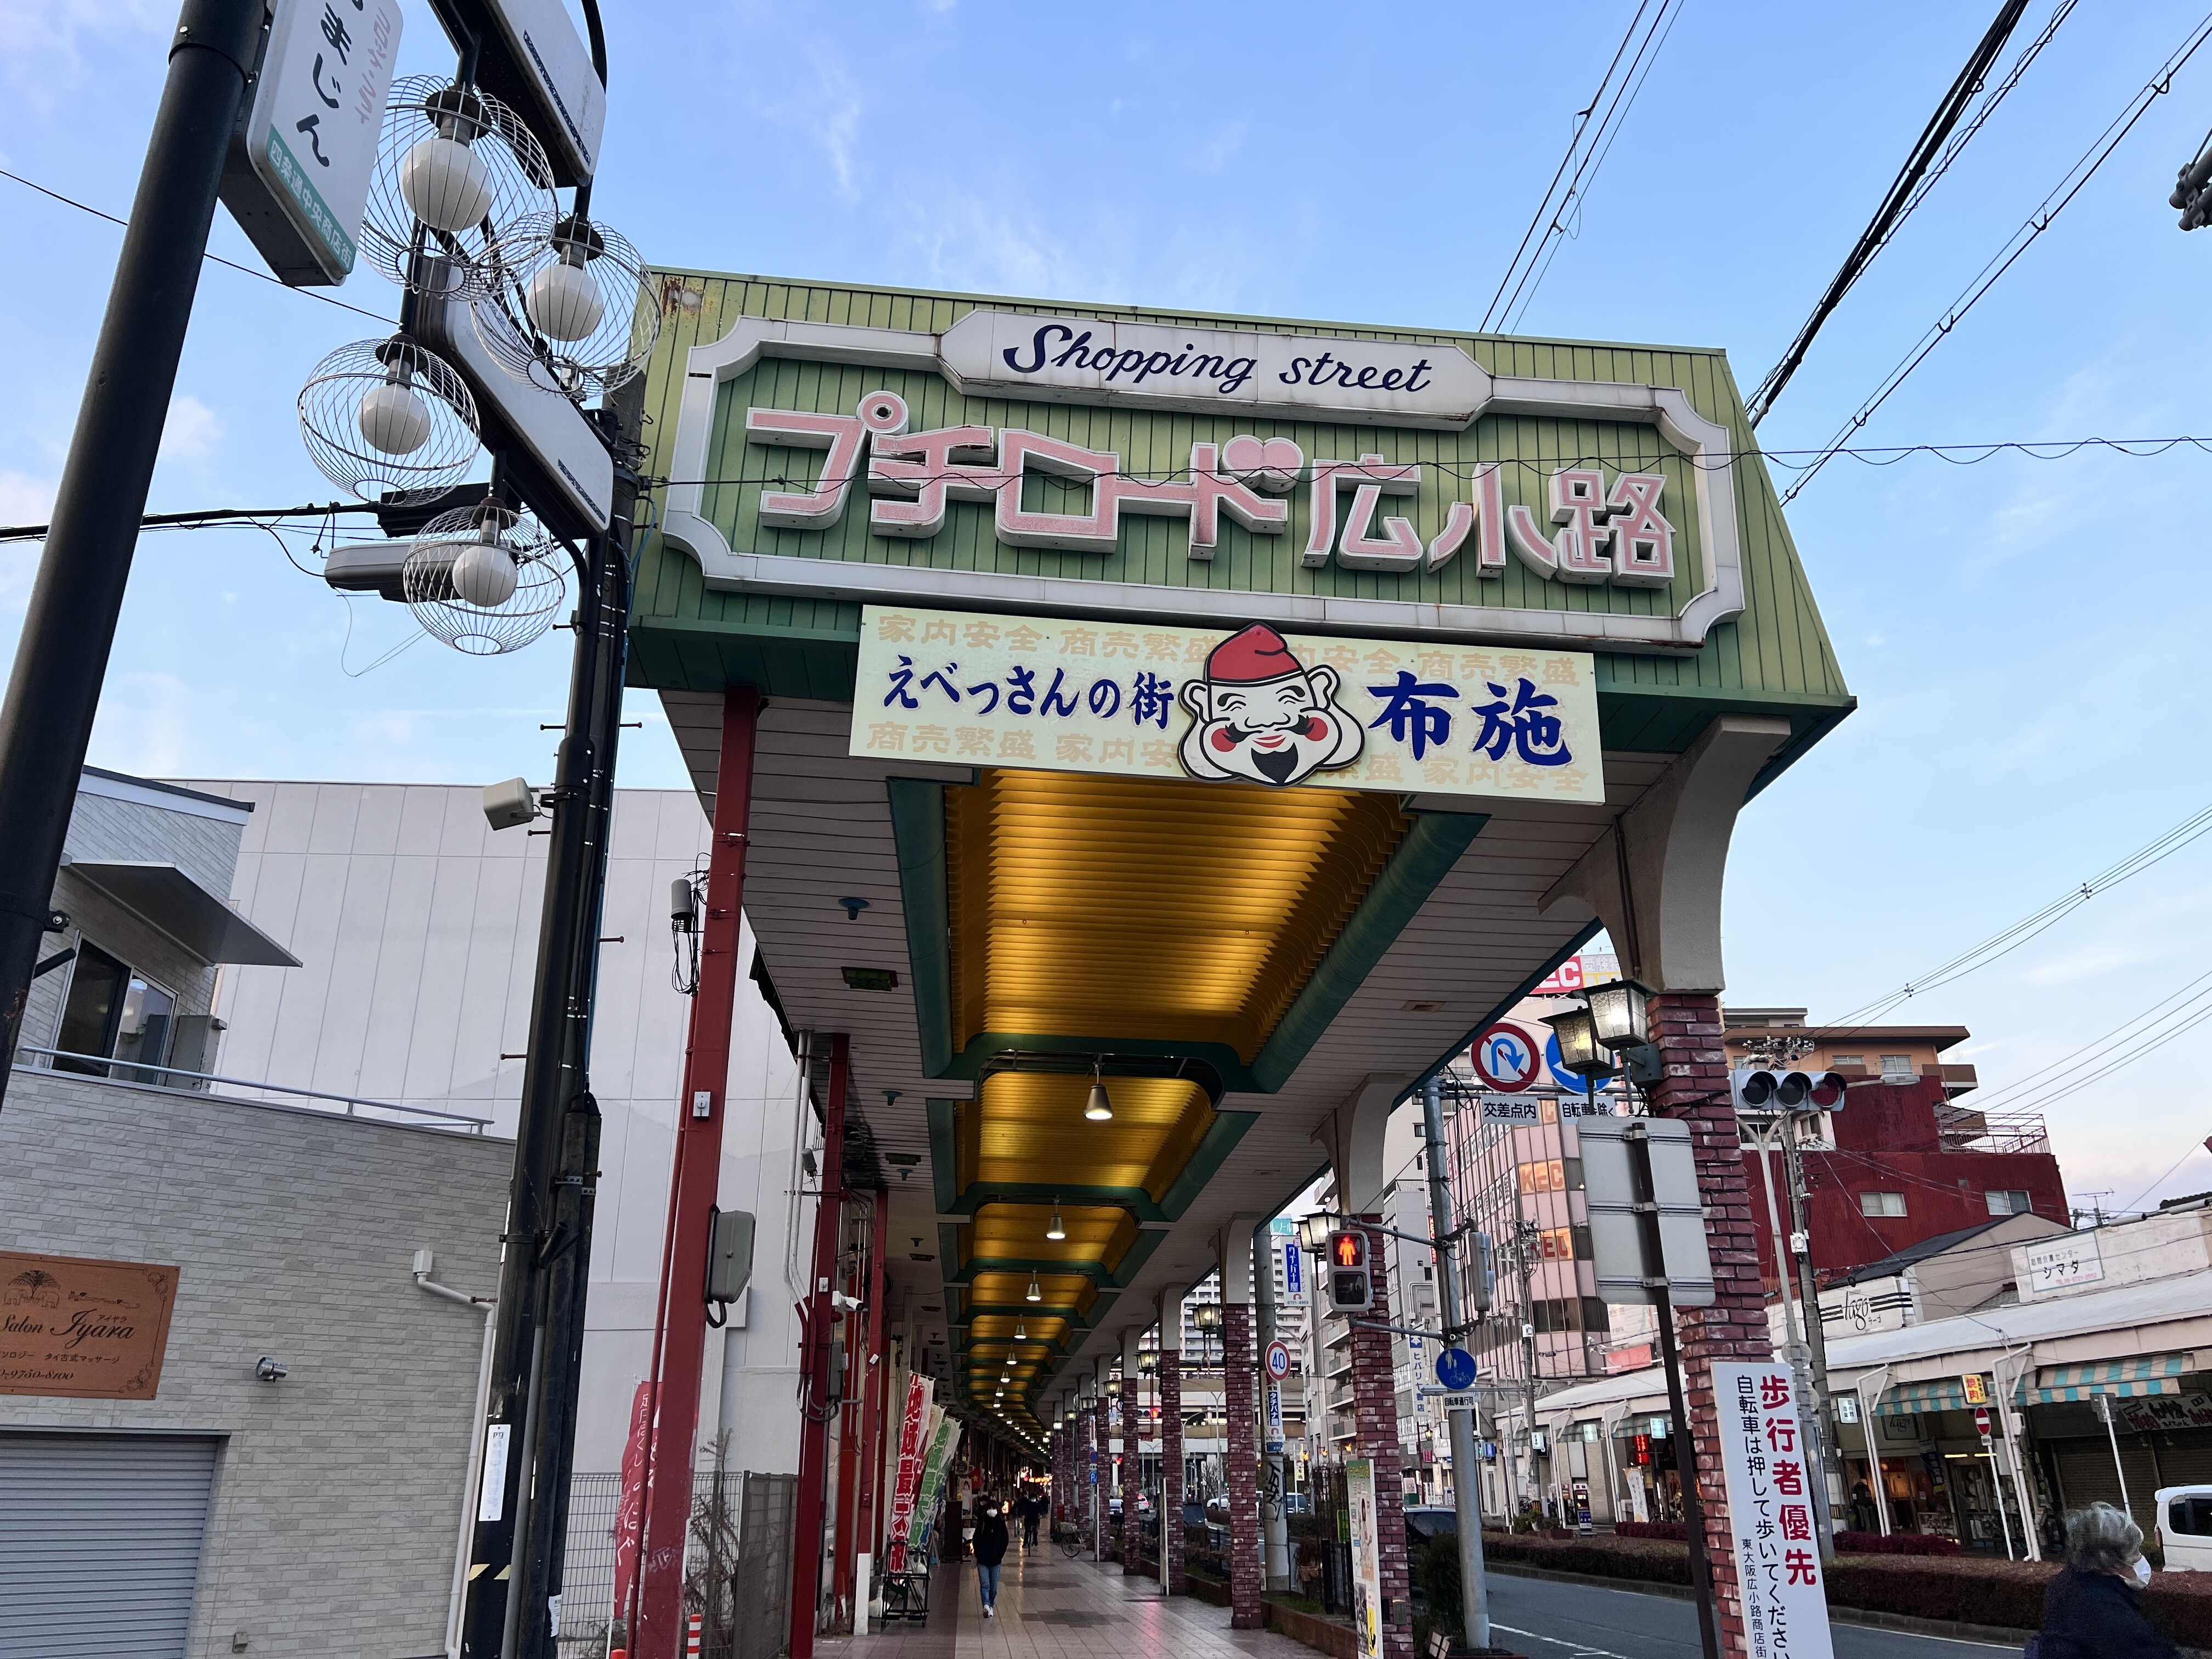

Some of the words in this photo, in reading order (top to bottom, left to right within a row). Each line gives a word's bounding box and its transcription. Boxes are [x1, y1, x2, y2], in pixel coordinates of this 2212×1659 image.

[296, 0, 363, 167] まじん
[270, 139, 352, 268] 四条通中央商店街
[1003, 323, 1257, 394] Shopping
[1278, 351, 1432, 393] street
[877, 614, 1043, 653] 家内安全
[1059, 627, 1219, 663] 商売繁盛
[1418, 650, 1581, 687] 商売繁盛
[883, 654, 1175, 730] えべっさんの街
[1366, 670, 1573, 766] 布施
[865, 720, 1037, 760] 商売繁盛
[1423, 757, 1590, 792] 家内安全
[1483, 1102, 1537, 1119] 交差点内
[1521, 1163, 1564, 1193] KEC
[0, 1314, 43, 1334] Salon
[0, 1350, 35, 1359] ソロジー
[44, 1352, 121, 1364] タイ古式マッサージ
[1272, 1352, 1285, 1370] 40
[1966, 1378, 1979, 1400] 焼肉
[1444, 1396, 1474, 1406] 自転車通行可
[1759, 1374, 1818, 1585] 歩行者優先
[1741, 1538, 1768, 1658] 東大阪広小路商店街
